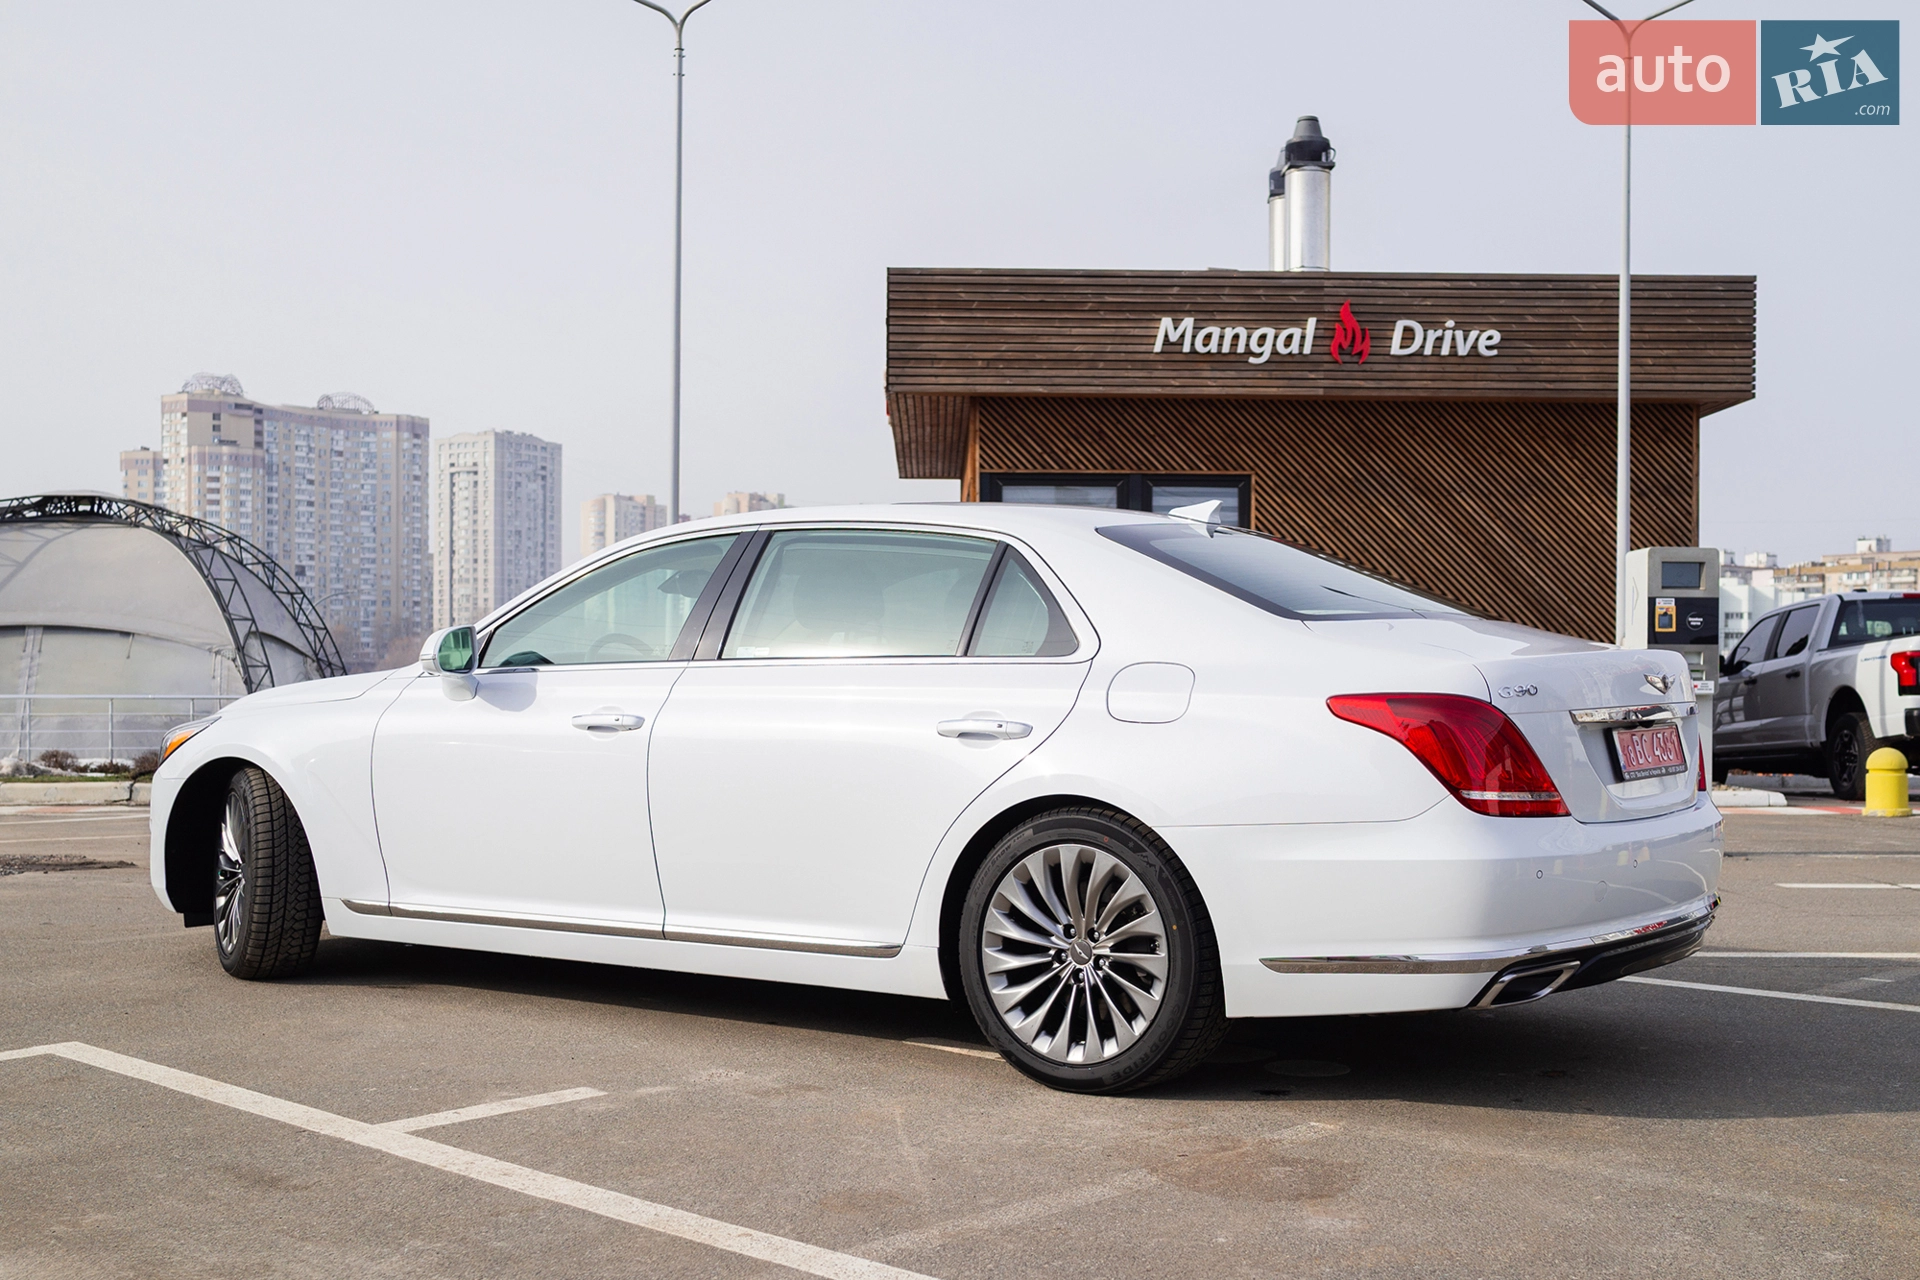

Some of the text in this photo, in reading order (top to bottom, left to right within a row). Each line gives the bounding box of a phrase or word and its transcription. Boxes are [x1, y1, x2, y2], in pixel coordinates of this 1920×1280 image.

[1153, 317, 1501, 364] Mangal Drive
[1498, 683, 1538, 698] G90
[1110, 1003, 1181, 1082] GOODRIDE
